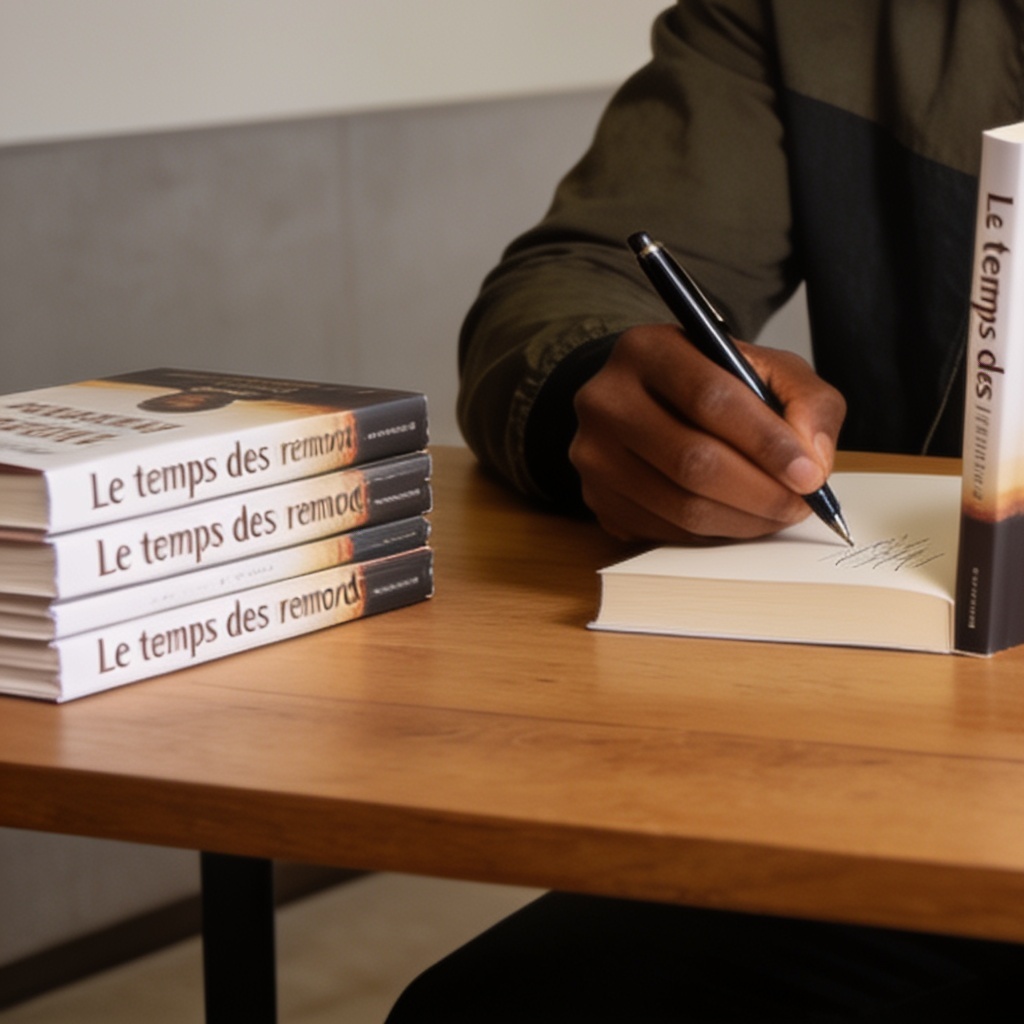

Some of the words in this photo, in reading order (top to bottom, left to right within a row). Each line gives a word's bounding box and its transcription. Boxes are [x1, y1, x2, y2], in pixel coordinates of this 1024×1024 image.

[985, 193, 1014, 230] Le
[970, 240, 1011, 340] temps
[975, 349, 1005, 400] des
[89, 472, 125, 510] Le
[133, 457, 217, 499] temps
[226, 440, 270, 478] des
[97, 539, 131, 576] Le
[140, 522, 224, 564] temps
[232, 504, 277, 542] des
[98, 637, 131, 675] Le
[139, 618, 218, 660] temps
[226, 599, 270, 638] des
